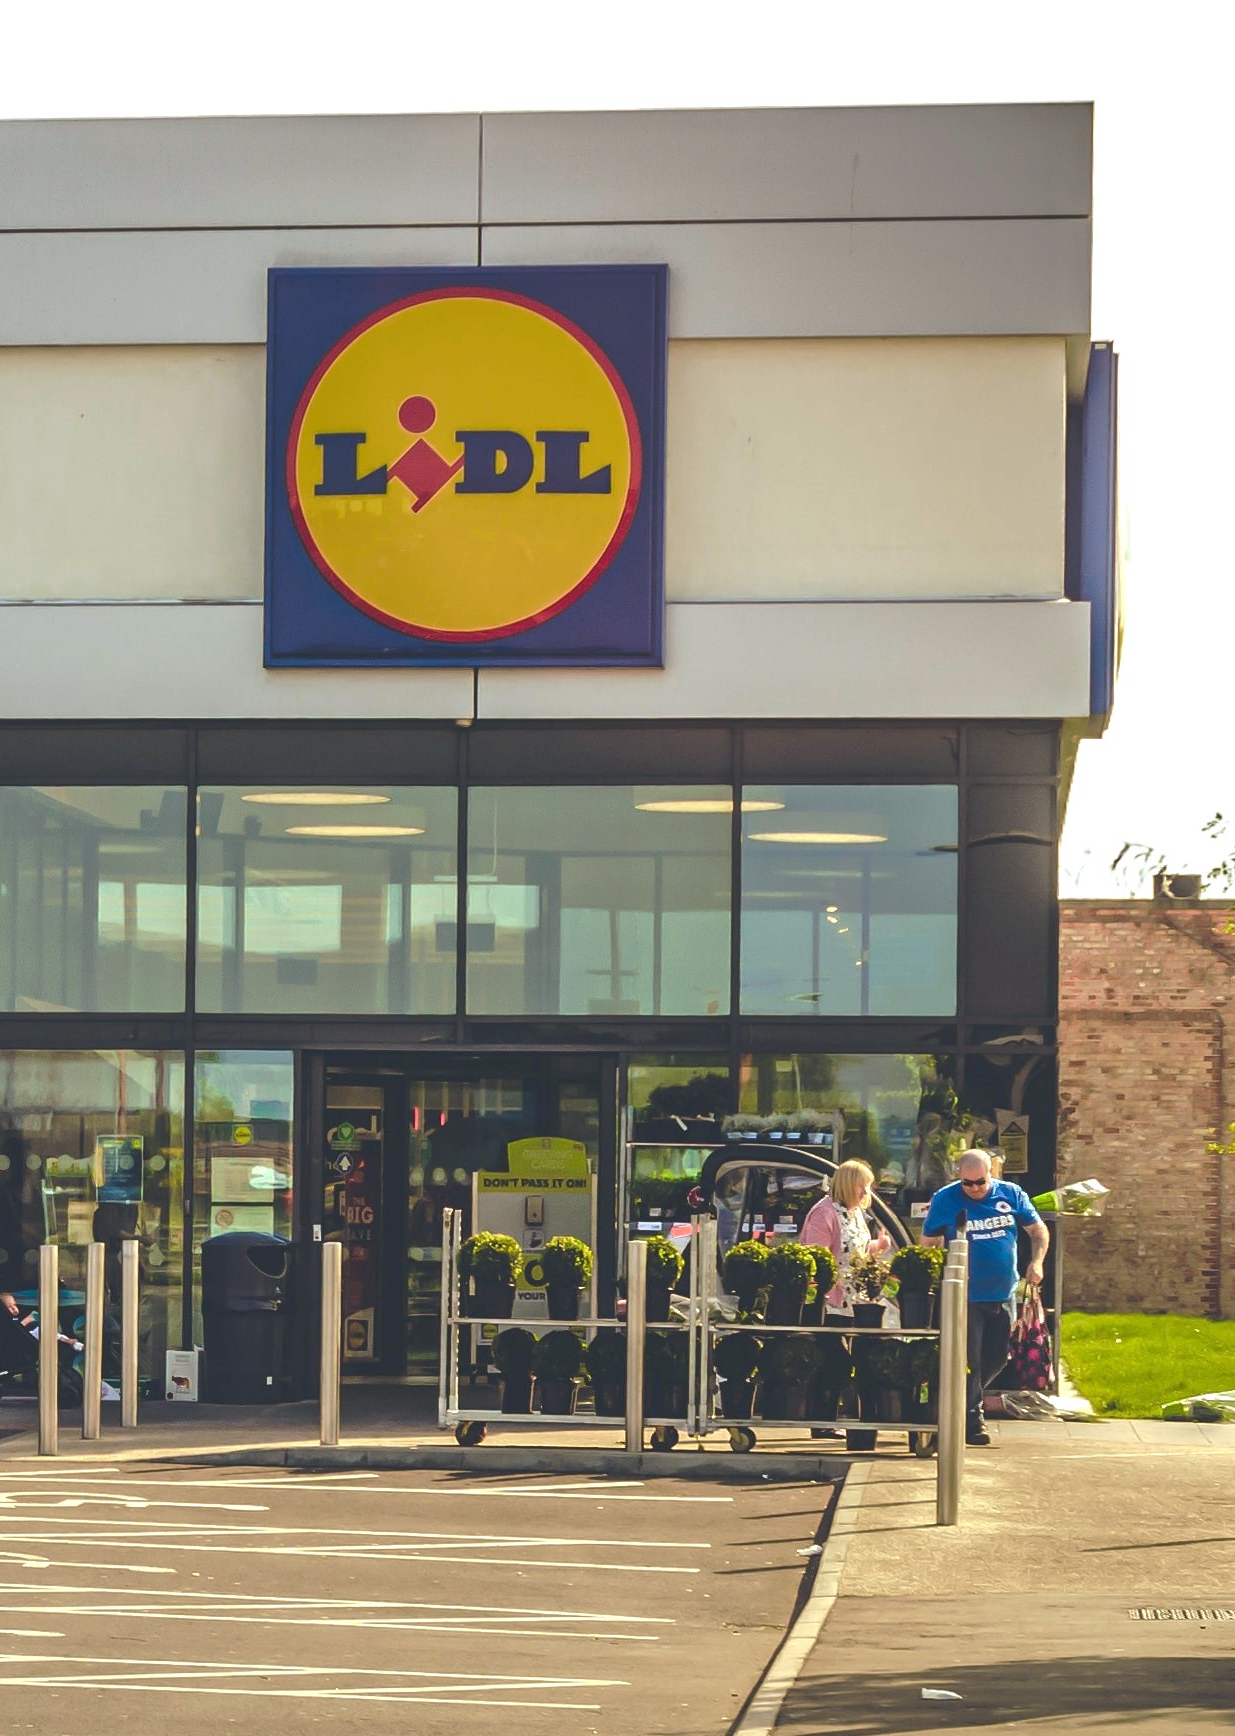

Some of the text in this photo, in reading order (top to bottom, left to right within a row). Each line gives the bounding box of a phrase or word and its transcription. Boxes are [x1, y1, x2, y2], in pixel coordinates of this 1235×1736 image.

[484, 1178, 519, 1188] DON'T
[521, 1178, 549, 1188] PASS
[552, 1178, 564, 1188] IT
[347, 1206, 374, 1224] BIG
[966, 1213, 1015, 1232] ANGERS
